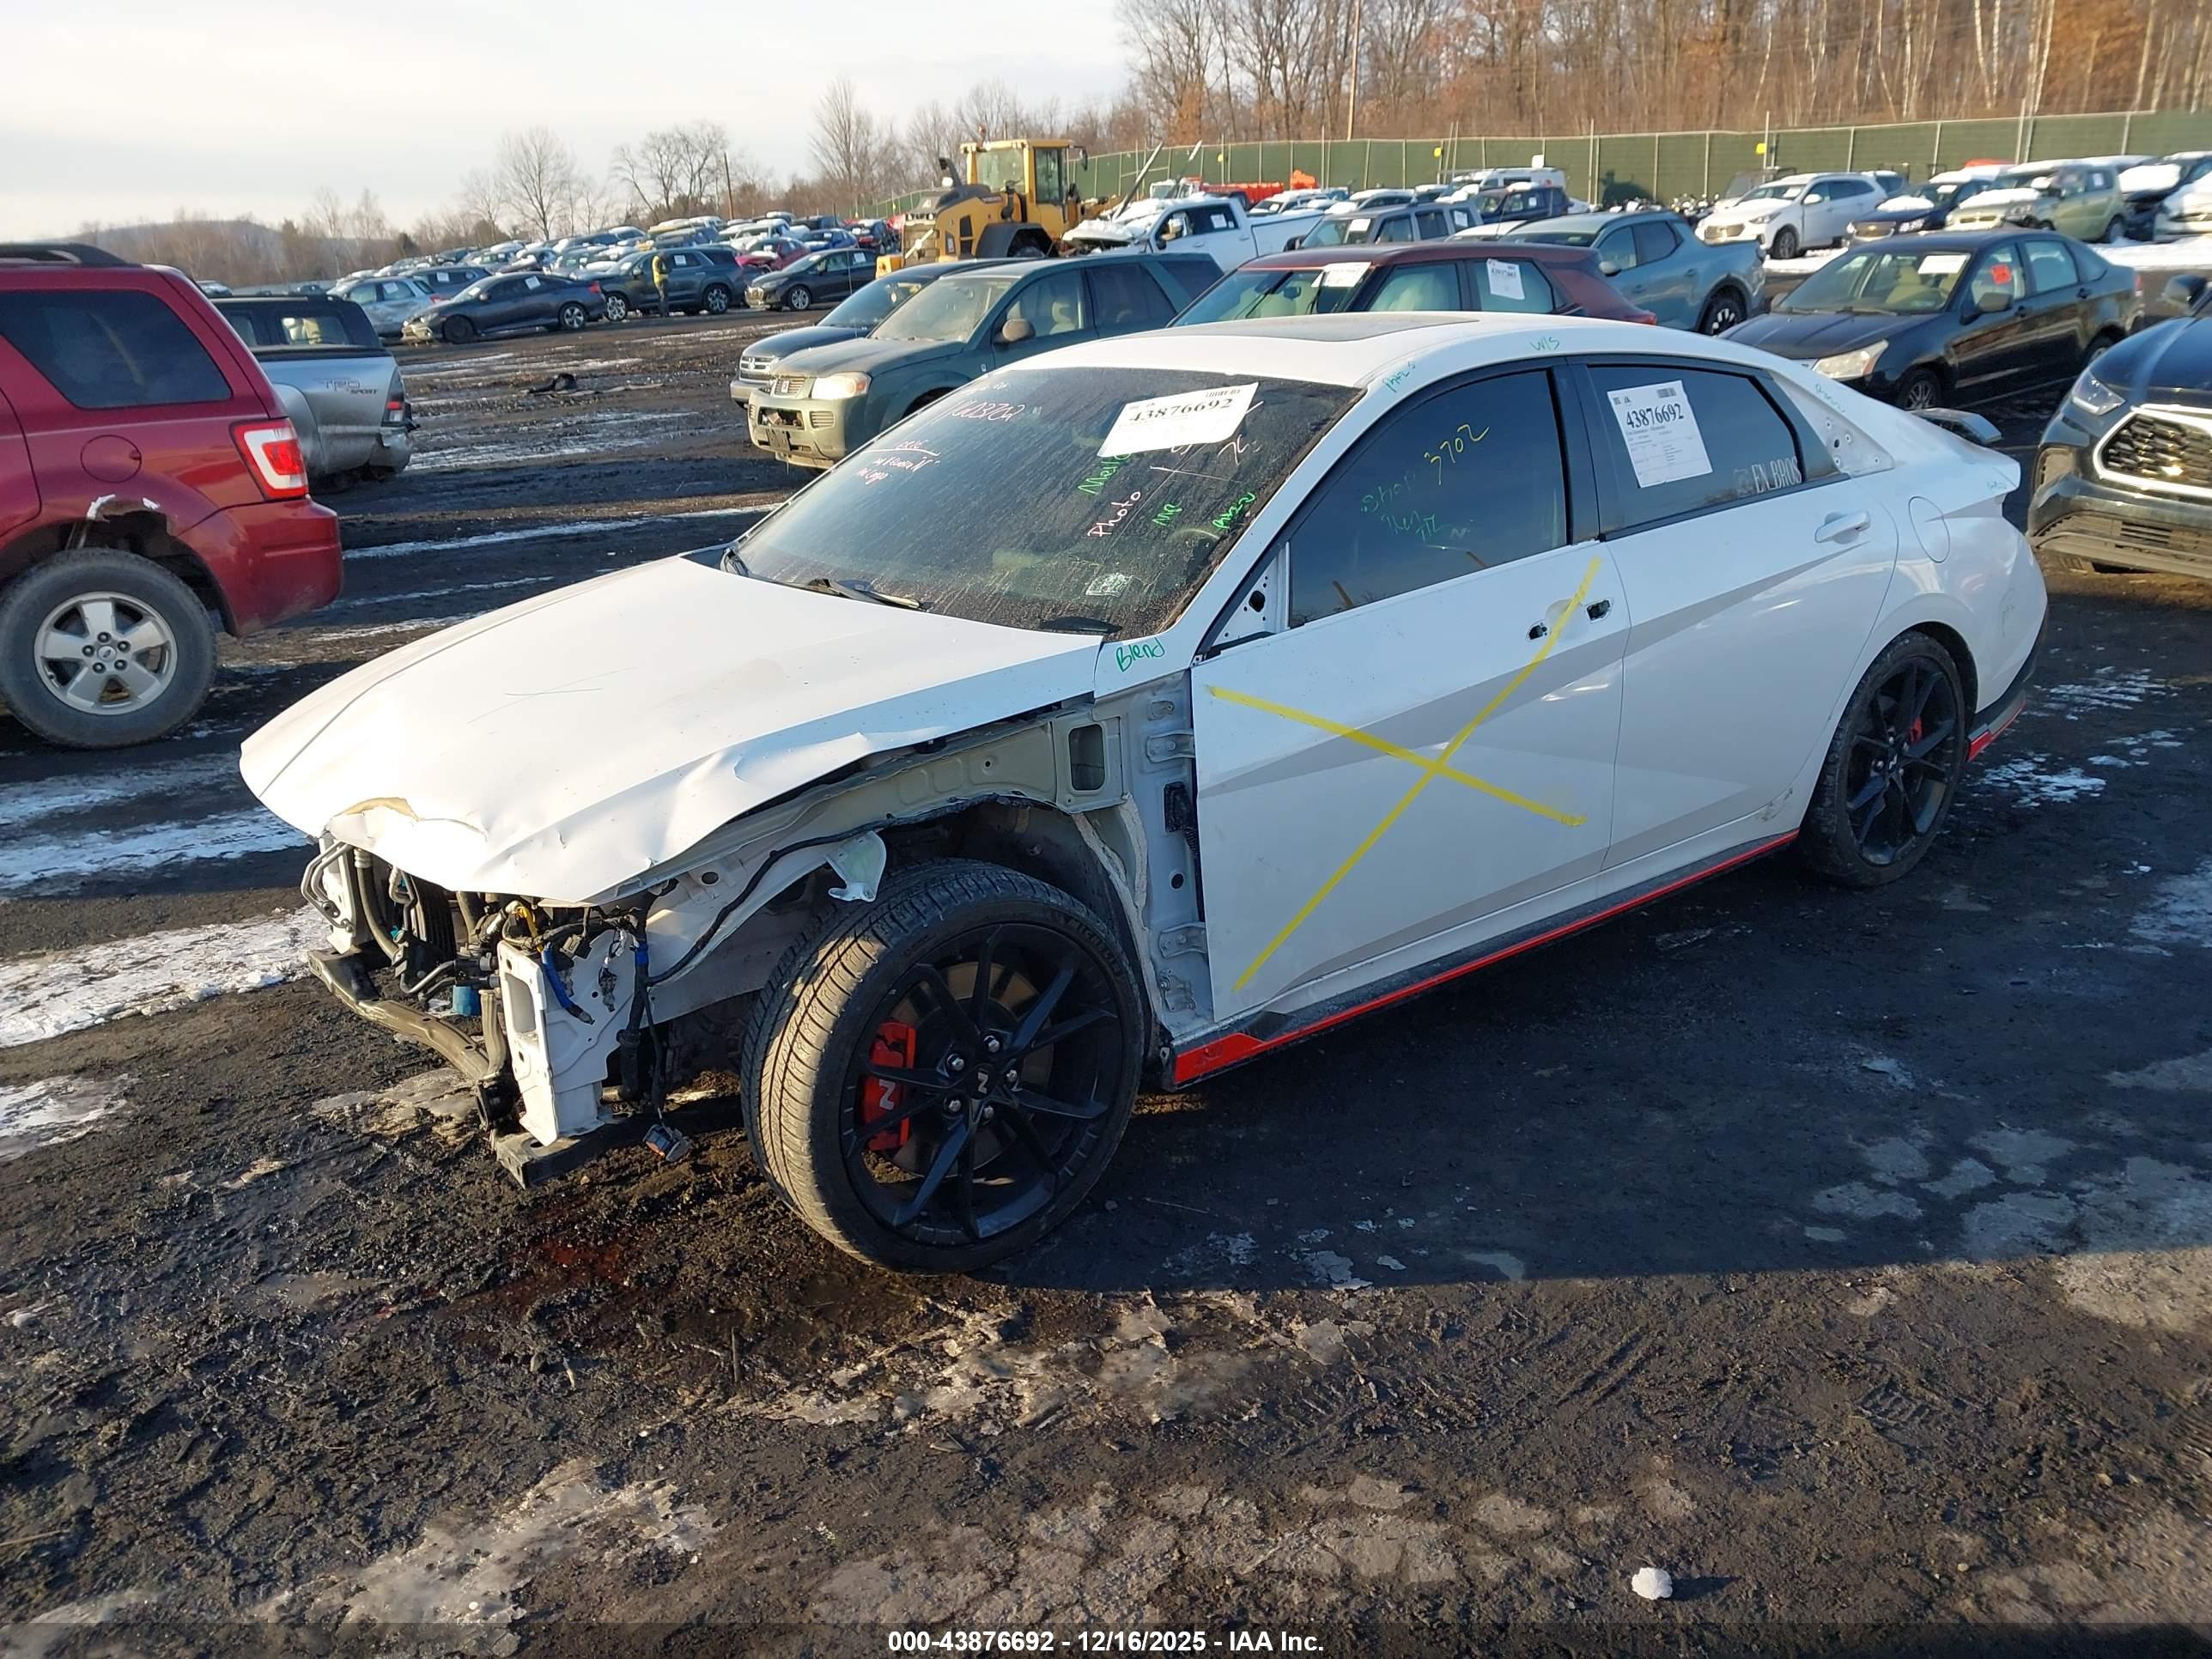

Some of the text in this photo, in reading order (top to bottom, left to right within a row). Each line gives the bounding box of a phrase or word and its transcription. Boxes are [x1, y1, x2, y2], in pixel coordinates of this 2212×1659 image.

[1128, 398, 1234, 422] 43876692
[1626, 403, 1685, 429] 43876692
[1087, 491, 1142, 538] Photo
[1115, 637, 1166, 672] Blend
